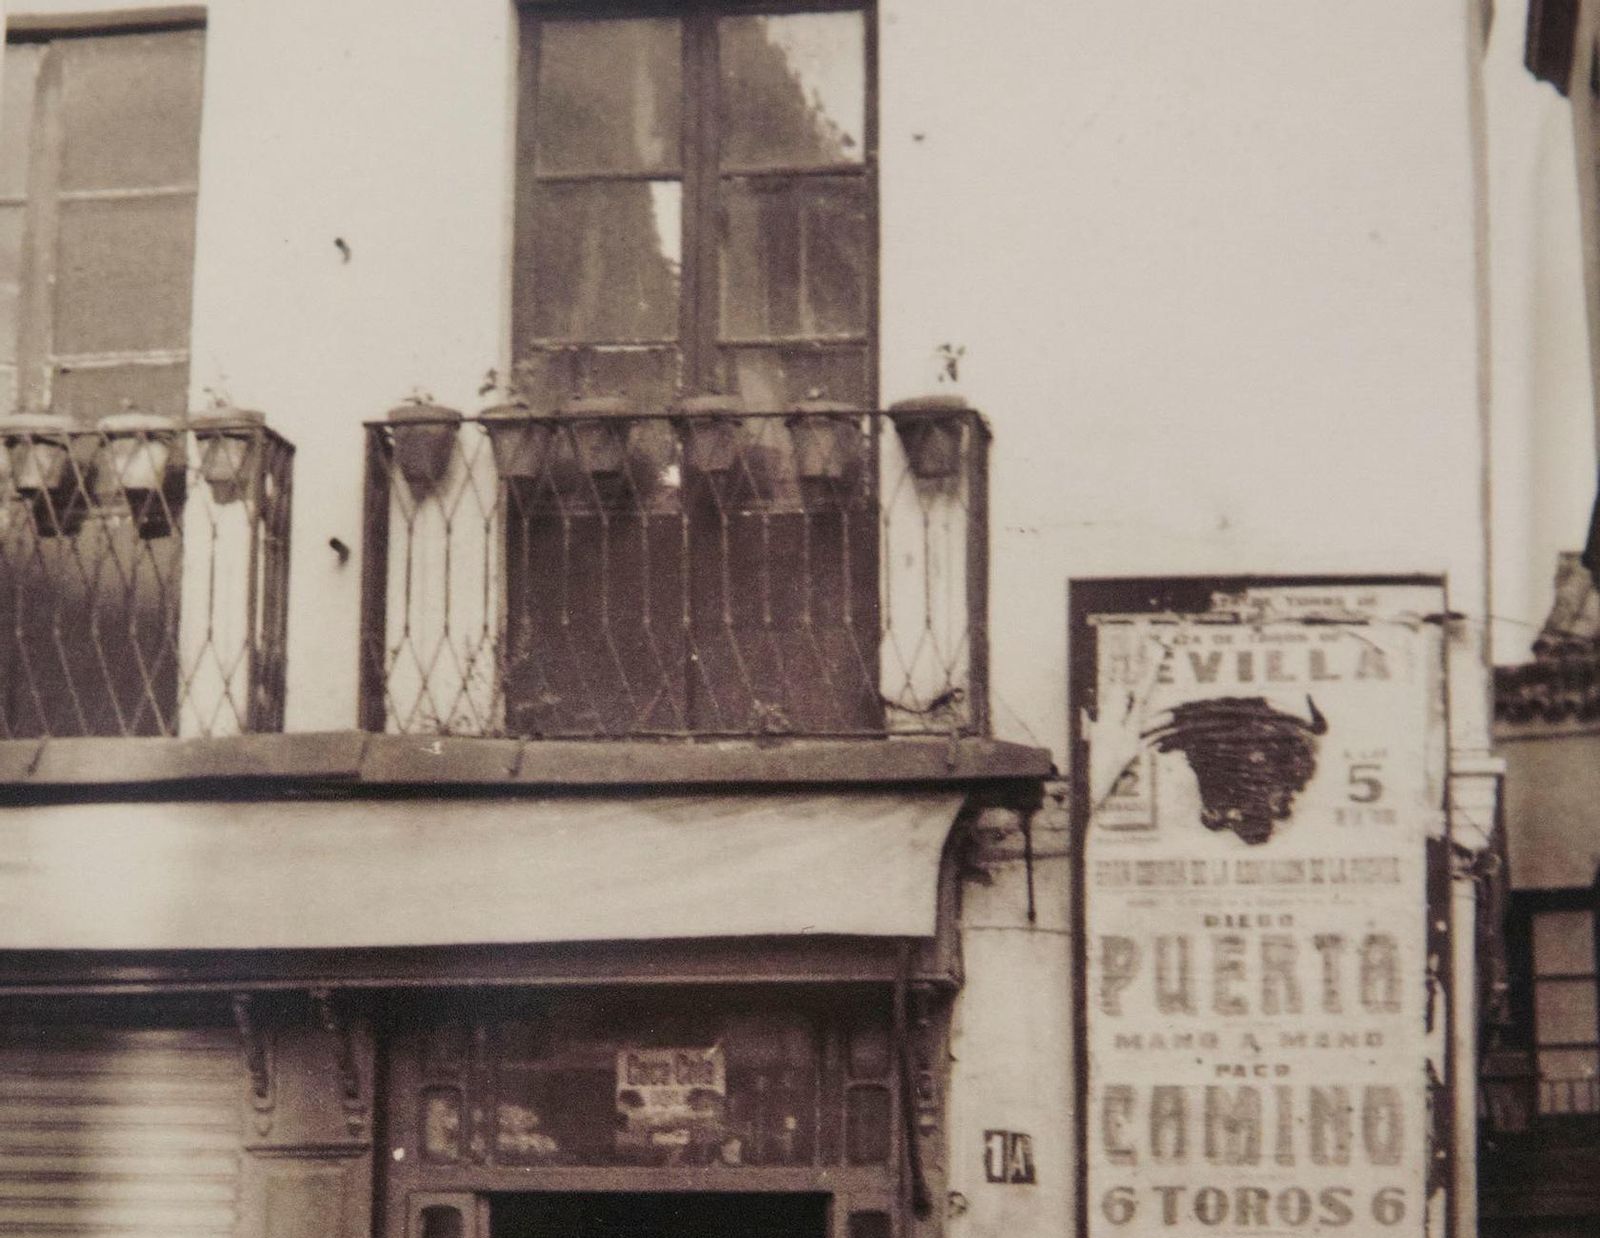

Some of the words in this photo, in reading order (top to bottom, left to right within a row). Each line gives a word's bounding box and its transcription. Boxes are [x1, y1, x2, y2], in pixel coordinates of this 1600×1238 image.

[1155, 648, 1392, 684] EVILLA
[1348, 763, 1384, 804] 5
[1203, 913, 1294, 928] DIEGO
[1098, 933, 1403, 1017] PUERTA
[1114, 1032, 1219, 1050] MANO
[1240, 1032, 1261, 1050] A
[1278, 1031, 1385, 1048] MANO
[1102, 1084, 1403, 1168] CAMINO
[1101, 1186, 1137, 1226] 6
[1151, 1185, 1355, 1227] TOROS
[1370, 1186, 1407, 1227] 6
